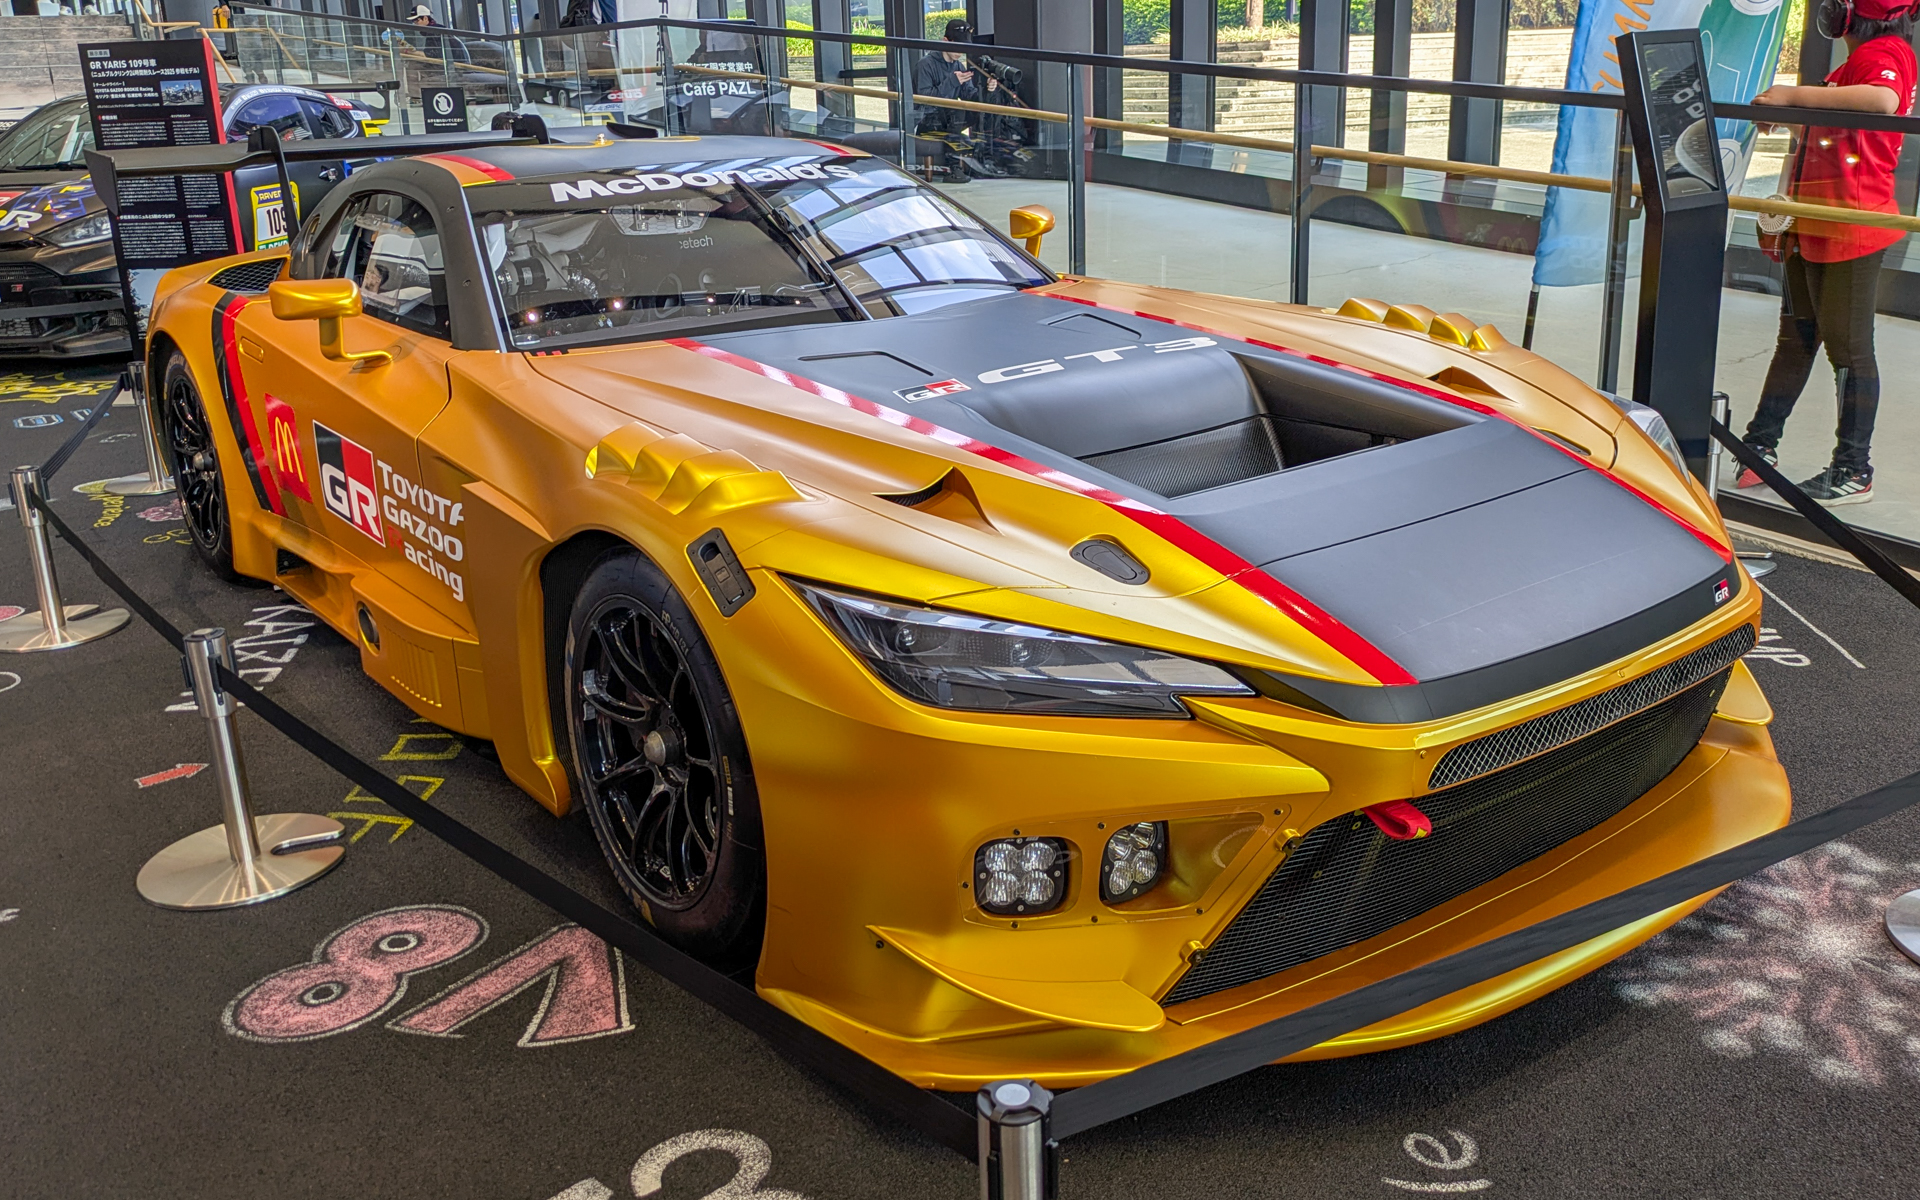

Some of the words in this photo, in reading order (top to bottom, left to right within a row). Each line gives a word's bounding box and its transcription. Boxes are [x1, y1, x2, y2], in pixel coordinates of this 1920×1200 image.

[89, 61, 101, 70] GR
[102, 60, 127, 69] YARIS
[128, 59, 157, 68] 109号車
[683, 81, 716, 96] Café
[719, 81, 757, 95] PAZL
[550, 163, 859, 203] McDonald's
[977, 337, 1218, 384] GT3
[904, 383, 971, 401] GR
[322, 463, 382, 539] GR
[377, 459, 464, 527] TOYOTA
[382, 495, 463, 562] GAZOO
[387, 525, 464, 602] Racing
[1715, 586, 1730, 603] GR
